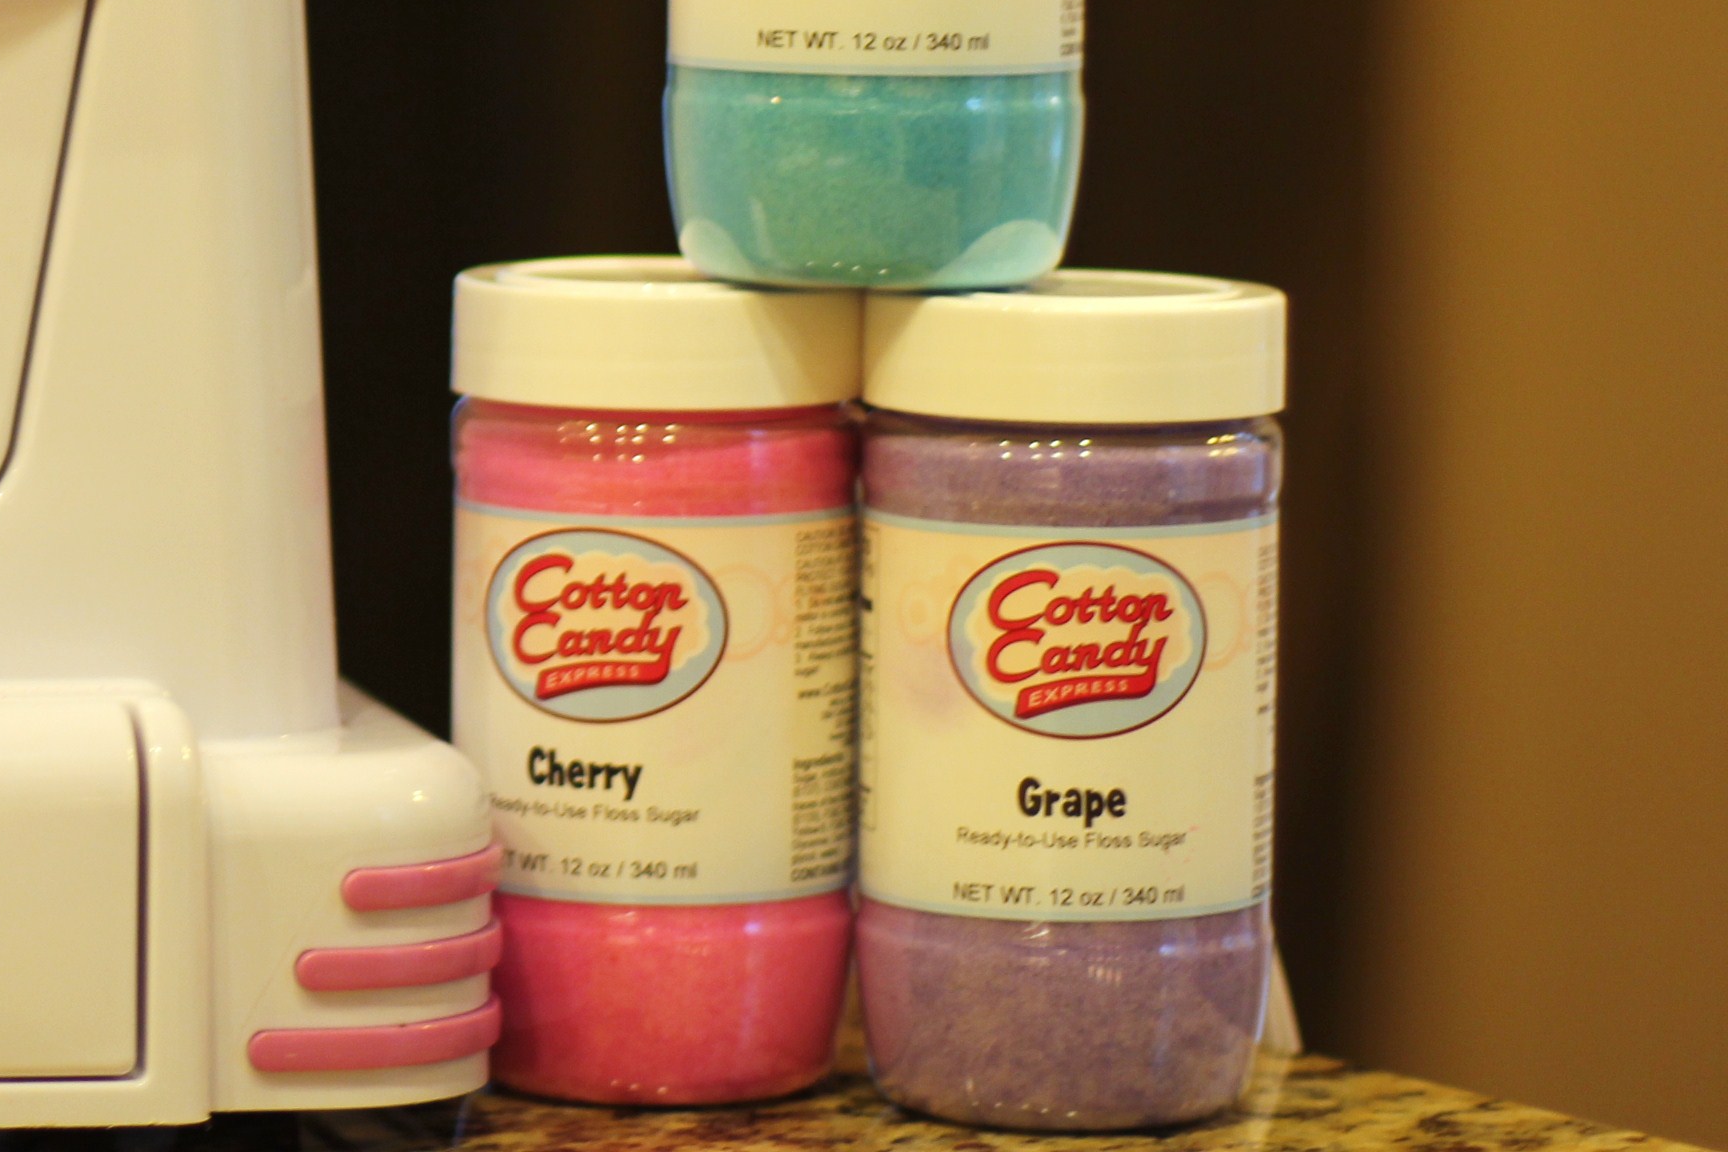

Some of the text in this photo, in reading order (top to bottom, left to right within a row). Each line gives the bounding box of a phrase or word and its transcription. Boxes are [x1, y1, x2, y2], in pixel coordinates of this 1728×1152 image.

[756, 29, 991, 52] NET WT. 12 oz / 340 ml
[513, 553, 689, 615] Cotton
[987, 568, 1174, 632] Cotton
[511, 608, 683, 666] Candy
[985, 623, 1170, 685] Candy
[545, 664, 641, 690] EXPRESS
[1027, 678, 1130, 708] EXPRESS
[527, 745, 643, 801] Cherry
[591, 803, 641, 823] Floss
[645, 805, 700, 828] Sugar
[1017, 775, 1128, 828] Grape
[955, 825, 1189, 855] Ready-to-Use Floss Sugar
[560, 856, 584, 876] 12
[588, 861, 611, 878] oz
[616, 860, 624, 878] /
[629, 861, 668, 880] 340
[673, 861, 699, 880] ml
[953, 881, 1186, 907] NET WT. 12 oz / 340 ml
